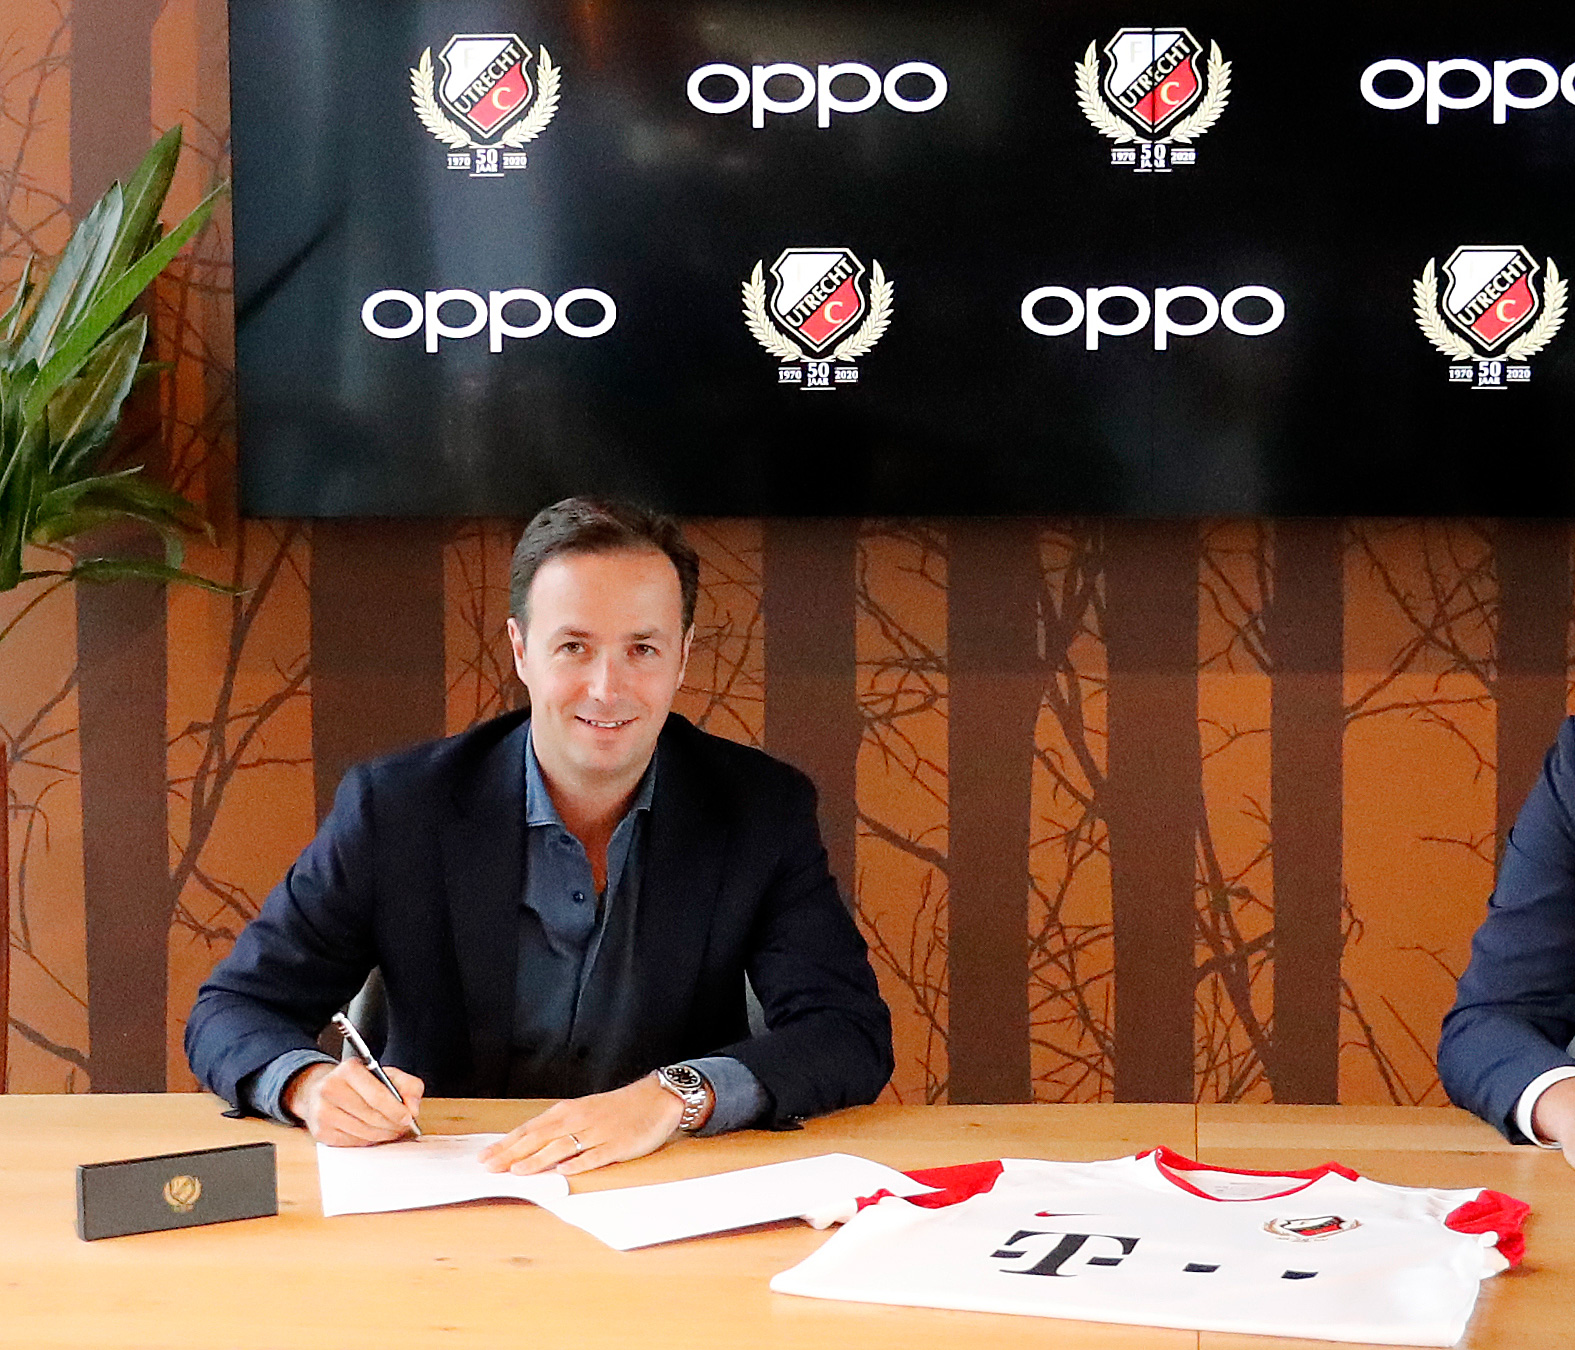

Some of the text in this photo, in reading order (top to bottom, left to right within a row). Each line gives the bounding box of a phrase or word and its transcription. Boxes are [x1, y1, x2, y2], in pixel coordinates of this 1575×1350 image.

[453, 43, 521, 113] UTRECHT
[1119, 37, 1191, 108] UTRECHT
[491, 87, 511, 110] C
[686, 61, 948, 129] oppo
[1160, 81, 1180, 105] C
[475, 149, 498, 164] 50
[1111, 152, 1136, 161] 1970
[1140, 144, 1166, 160] 50
[1171, 152, 1196, 161] 2020
[448, 157, 471, 166] 1970
[503, 157, 527, 166] 2020
[785, 257, 853, 327] UTRECHT
[1457, 255, 1528, 326] UTRECHT
[823, 301, 843, 324] C
[1021, 285, 1285, 351] oppo
[1496, 299, 1516, 323] C
[361, 287, 617, 353] oppo
[778, 370, 802, 379] 1970
[807, 362, 830, 378] 50
[834, 370, 858, 379] 2020
[1449, 369, 1473, 378] 1970
[1478, 361, 1501, 377] 50
[1506, 369, 1531, 378] 2020
